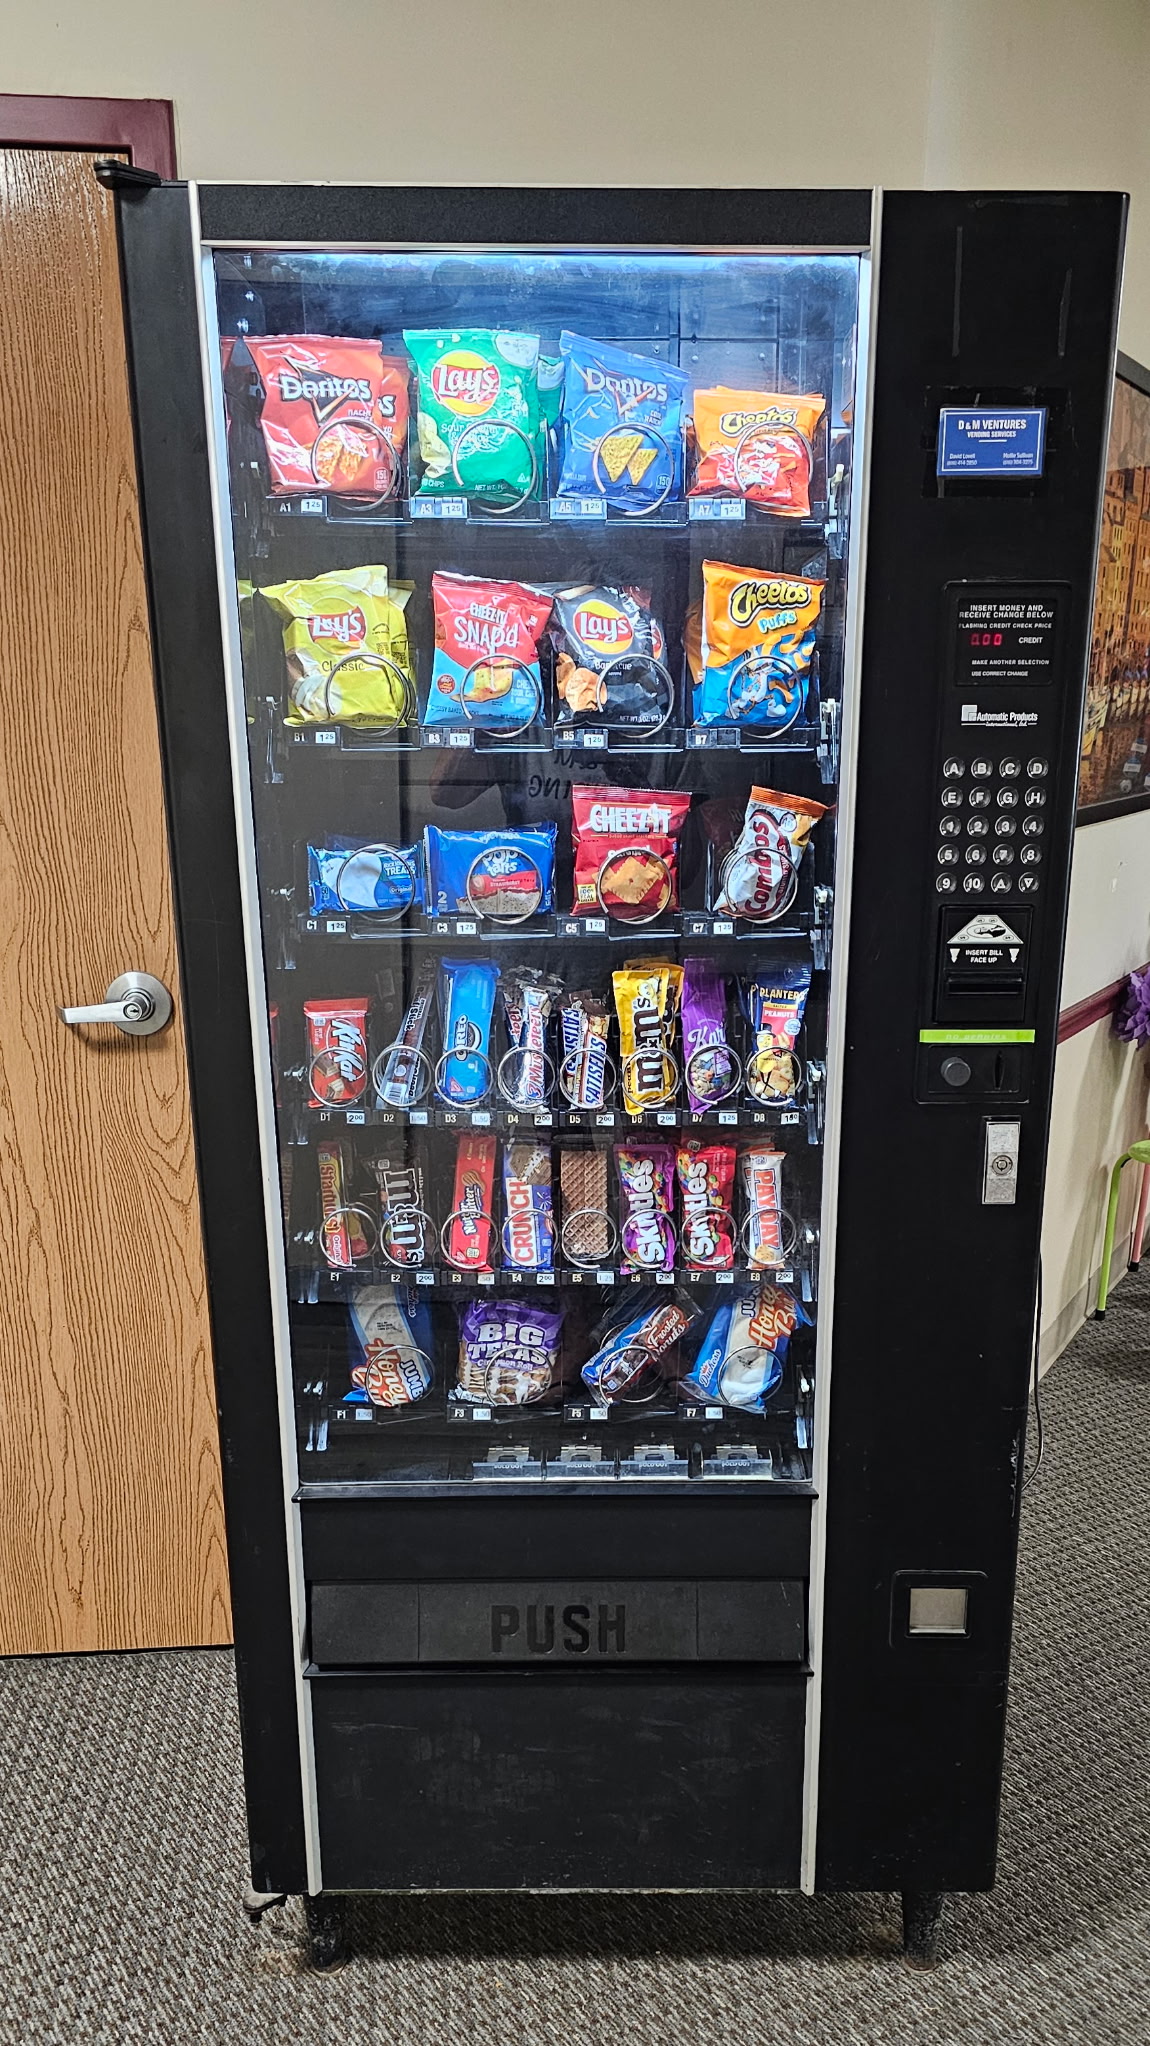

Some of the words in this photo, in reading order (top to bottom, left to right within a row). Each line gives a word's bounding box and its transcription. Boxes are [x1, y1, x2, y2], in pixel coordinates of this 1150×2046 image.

[281, 374, 371, 402] Doritos
[438, 364, 498, 402] Lay's
[584, 367, 668, 402] Doritos
[721, 408, 797, 435] Cheetos
[958, 420, 964, 430] D
[966, 422, 971, 430] &
[972, 420, 980, 429] M
[983, 419, 1027, 429] VENTURES
[441, 424, 464, 433] Sour
[280, 502, 291, 513] A1
[559, 503, 572, 513] A5
[731, 582, 809, 626] Cheetos
[312, 609, 361, 642] Lay's
[580, 611, 630, 642] Lay's
[977, 712, 1008, 721] Automatic
[1010, 712, 1038, 722] Products
[294, 733, 305, 742] B1
[563, 731, 575, 741] B5
[950, 763, 959, 773] A
[978, 763, 986, 773] B
[1005, 763, 1015, 773] C
[1033, 763, 1042, 773] D
[948, 793, 956, 803] E
[976, 793, 984, 803] F
[1003, 793, 1012, 803] G
[1031, 793, 1040, 803] H
[974, 822, 982, 832] 2
[1002, 822, 1009, 832] 3
[1029, 822, 1037, 831] 4
[944, 850, 952, 860] 5
[972, 850, 979, 860] 6
[999, 850, 1007, 860] 7
[1027, 850, 1034, 860] 8
[943, 878, 950, 888] 9
[968, 878, 980, 888] 10
[437, 891, 447, 904] 2
[307, 920, 317, 930] C1
[566, 924, 577, 933] C5
[764, 1010, 795, 1018] PEANUTS
[405, 1007, 419, 1032] Stick
[455, 1014, 468, 1061] OREO
[527, 1085, 543, 1099] 3
[321, 1113, 331, 1121] D1
[383, 1114, 395, 1122] D2
[445, 1114, 457, 1122] D3
[507, 1115, 519, 1124] D4
[569, 1115, 581, 1124] D5
[631, 1115, 643, 1124] D6
[692, 1114, 703, 1123] D7
[754, 1113, 765, 1122] D8
[755, 1170, 781, 1251] PAYDAY
[460, 1202, 476, 1234] Nuttr
[509, 1178, 535, 1263] CRUNCH
[330, 1273, 340, 1281] E1
[391, 1273, 400, 1282] E2
[452, 1274, 461, 1282] E3
[512, 1274, 522, 1282] E4
[572, 1274, 582, 1282] E5
[631, 1274, 640, 1282] E6
[690, 1272, 700, 1281] E7
[750, 1272, 760, 1281] E8
[750, 1284, 779, 1347] Honey
[648, 1310, 680, 1347] Frosted
[477, 1322, 545, 1346] BIG
[467, 1342, 549, 1365] TEXAS
[517, 1362, 533, 1370] Roll
[699, 1349, 721, 1388] Duchess
[368, 1339, 408, 1407] Honey
[399, 1359, 425, 1401] JUMB
[337, 1411, 346, 1419] F1
[454, 1409, 465, 1417] F3
[571, 1409, 582, 1417] F5
[687, 1409, 696, 1417] F7
[491, 1604, 626, 1654] PUSH
